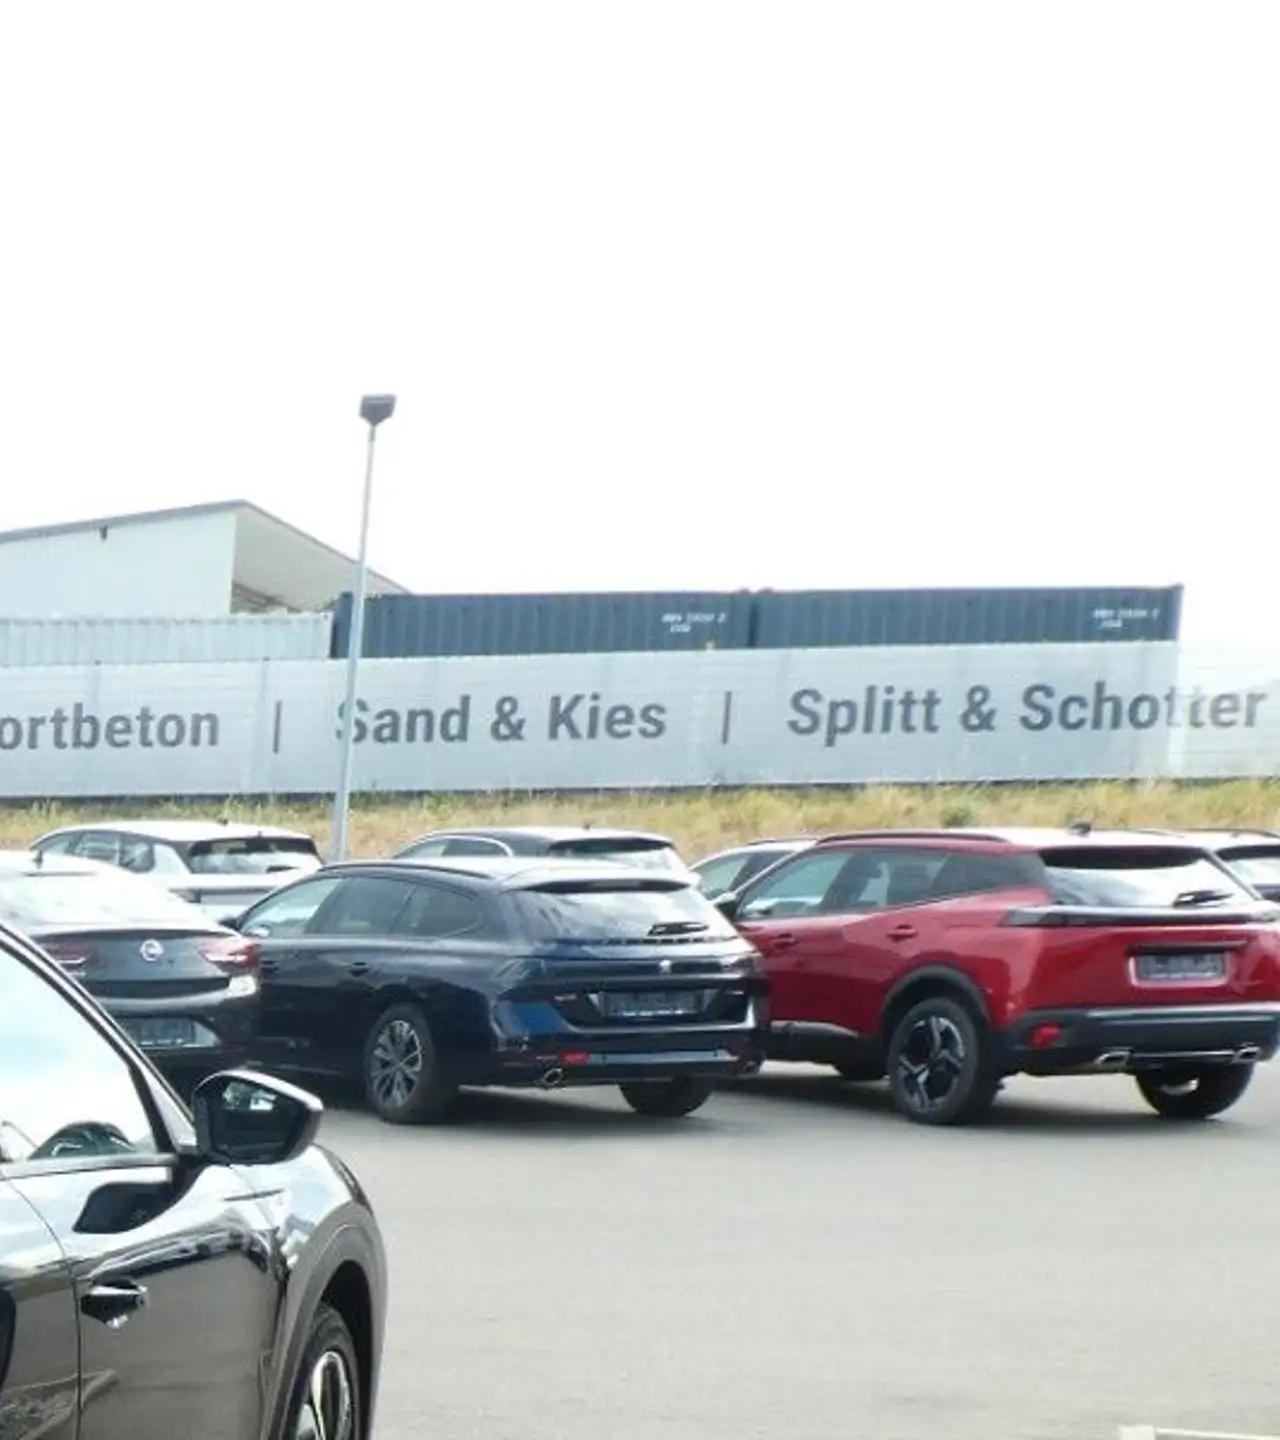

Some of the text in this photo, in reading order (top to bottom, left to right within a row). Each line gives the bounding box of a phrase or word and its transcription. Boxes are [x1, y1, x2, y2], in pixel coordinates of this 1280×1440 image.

[336, 694, 472, 744] Sand
[490, 695, 527, 742] &
[547, 691, 668, 740] Kies
[787, 684, 943, 747] Splitt
[958, 683, 997, 733] &
[1019, 680, 1269, 731] Schotter
